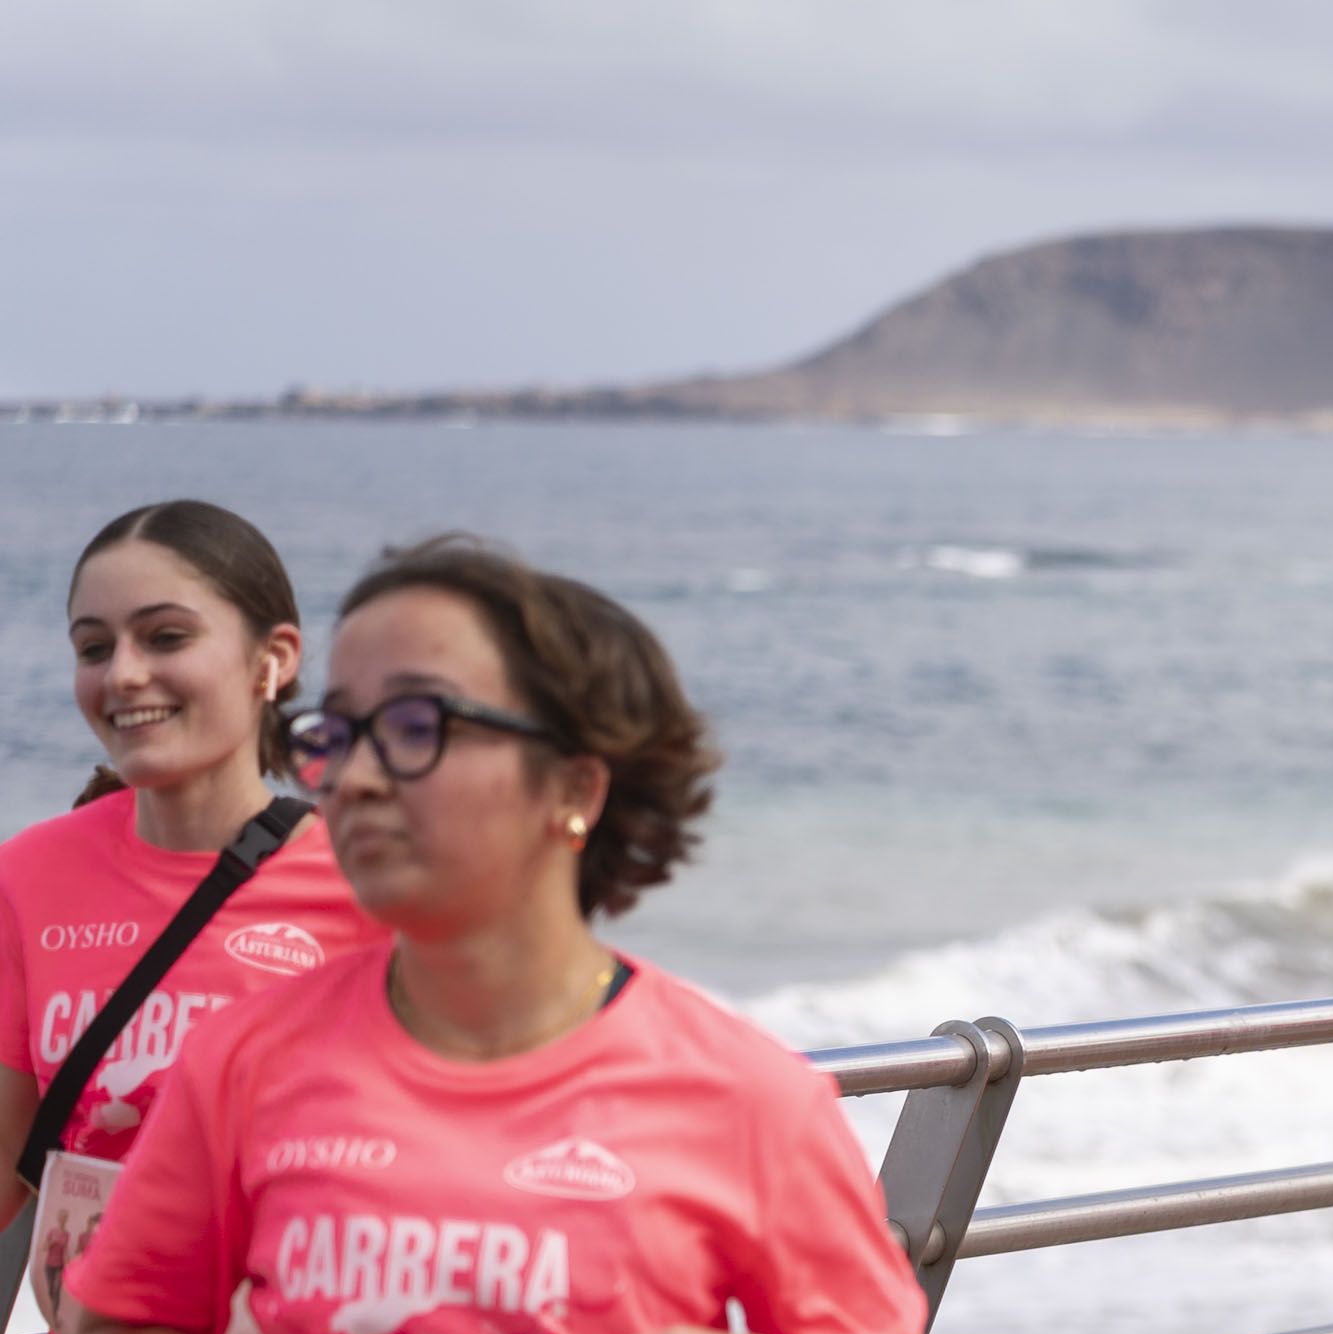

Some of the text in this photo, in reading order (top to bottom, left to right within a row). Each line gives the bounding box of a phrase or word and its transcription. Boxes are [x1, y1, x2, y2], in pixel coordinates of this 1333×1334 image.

[41, 921, 140, 951] OYSHO
[265, 1136, 397, 1172] OYSHO
[276, 1214, 571, 1318] CARRERA
